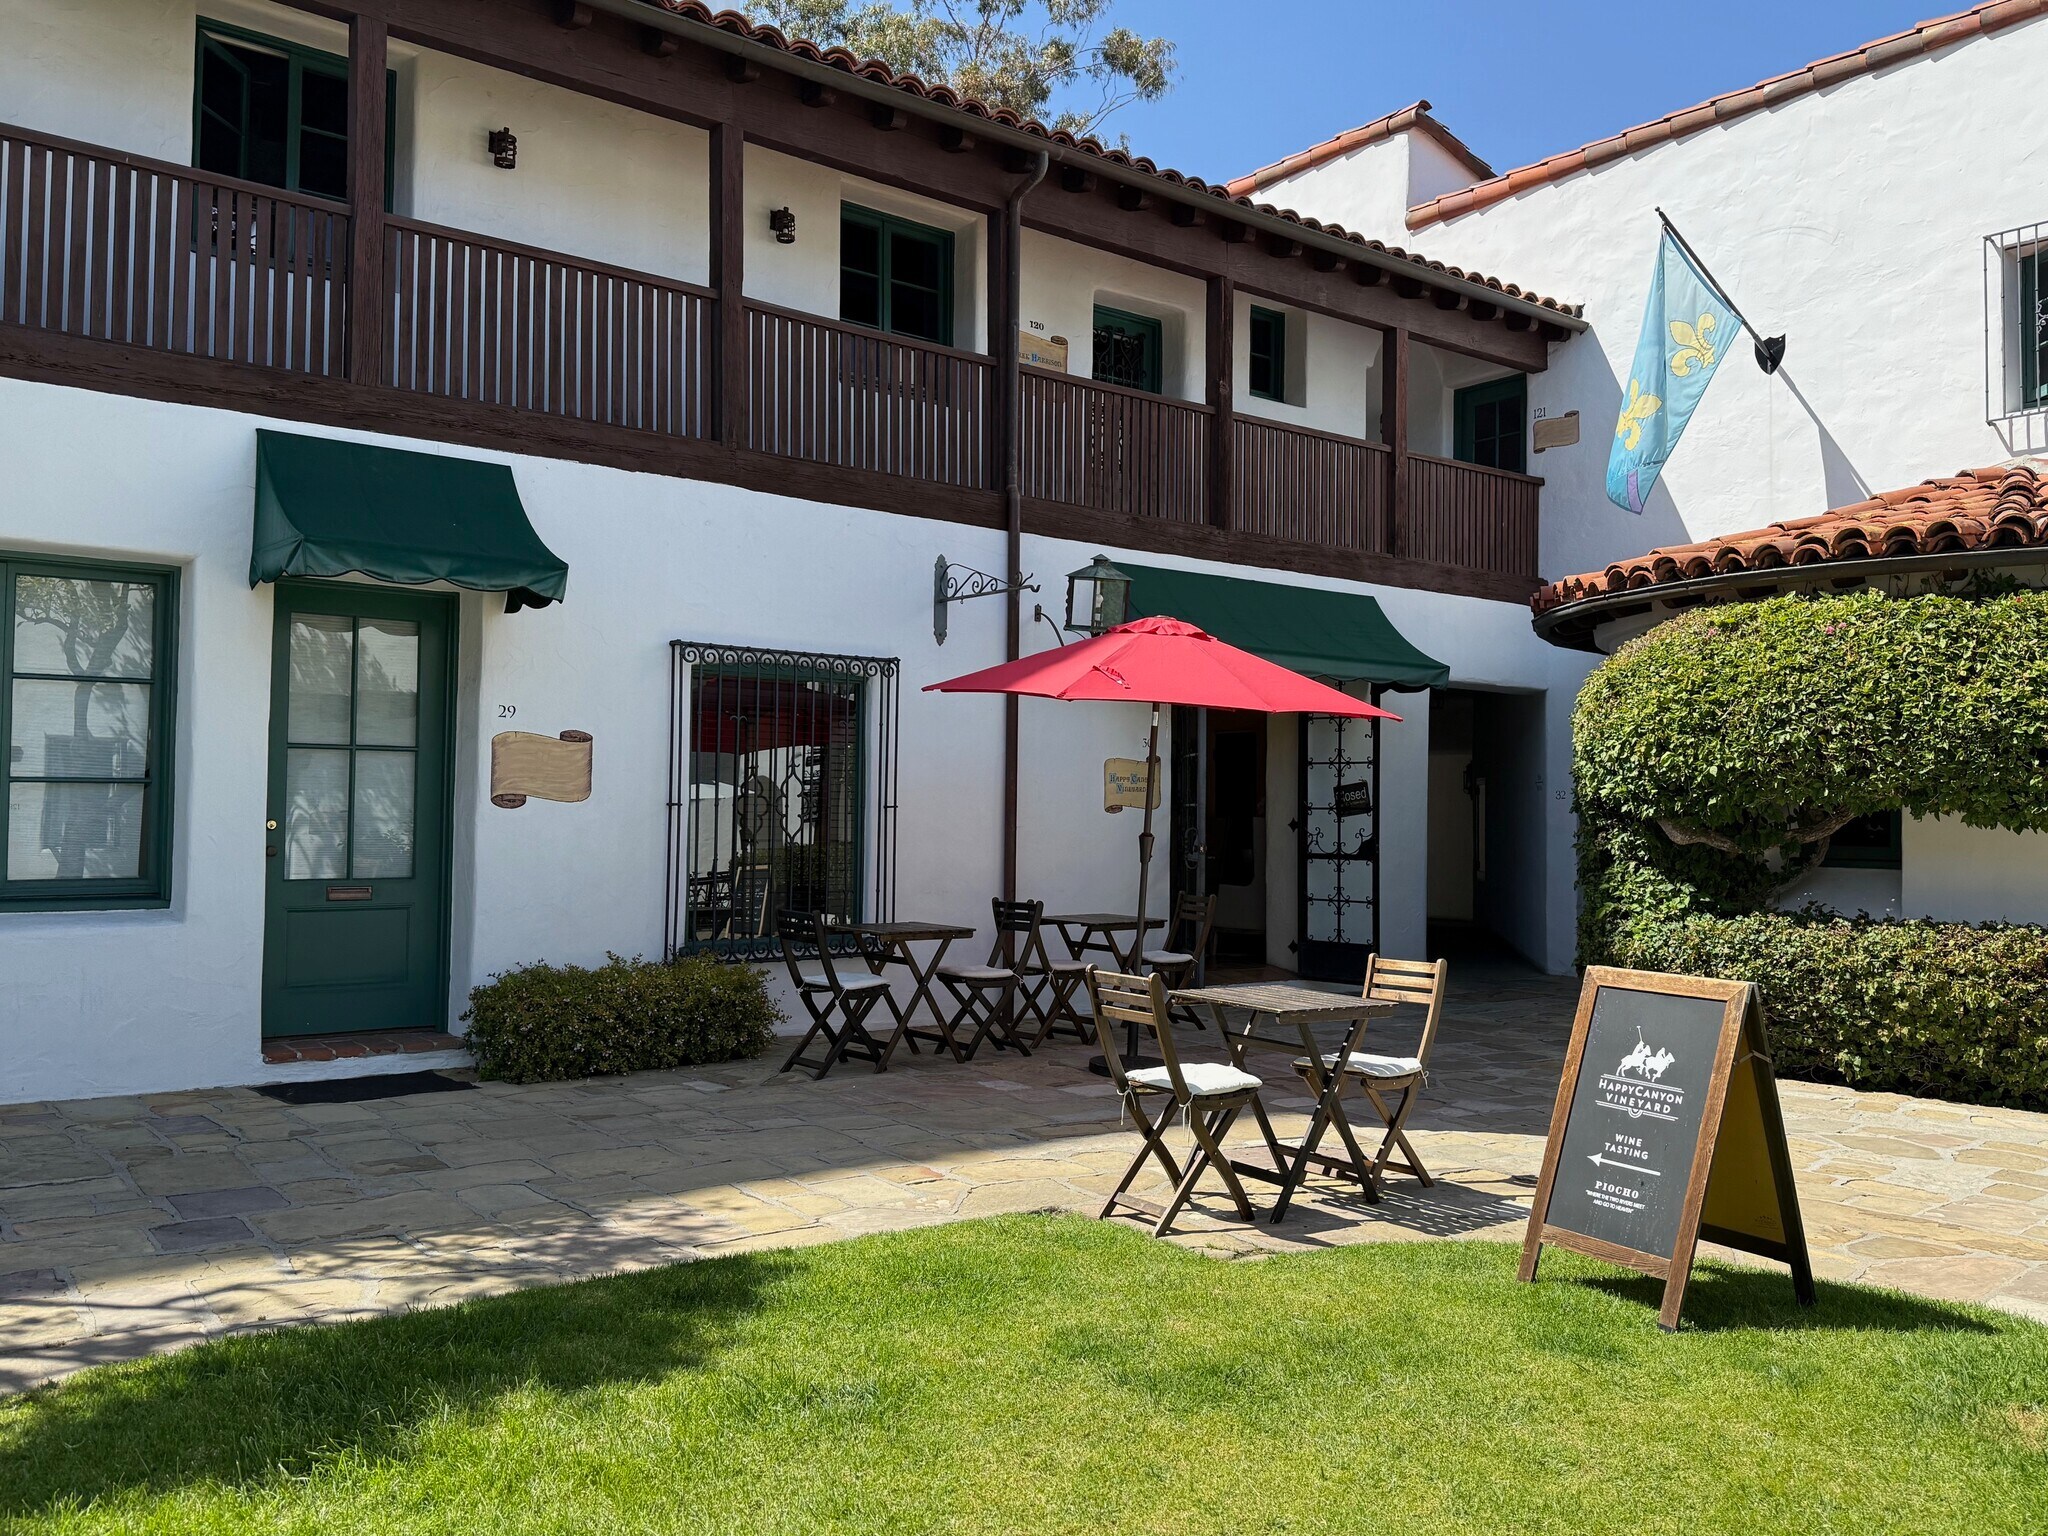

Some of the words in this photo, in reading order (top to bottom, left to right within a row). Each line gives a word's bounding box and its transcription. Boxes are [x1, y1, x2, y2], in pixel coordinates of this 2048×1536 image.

[1029, 320, 1045, 331] 120
[1533, 407, 1546, 419] 121
[498, 704, 516, 719] 29
[1555, 790, 1566, 800] 32
[1605, 1092, 1671, 1114] VINEYARD
[1615, 1133, 1643, 1148] WINE
[1604, 1142, 1649, 1160] TASTING
[1594, 1180, 1640, 1199] PIOCHO
